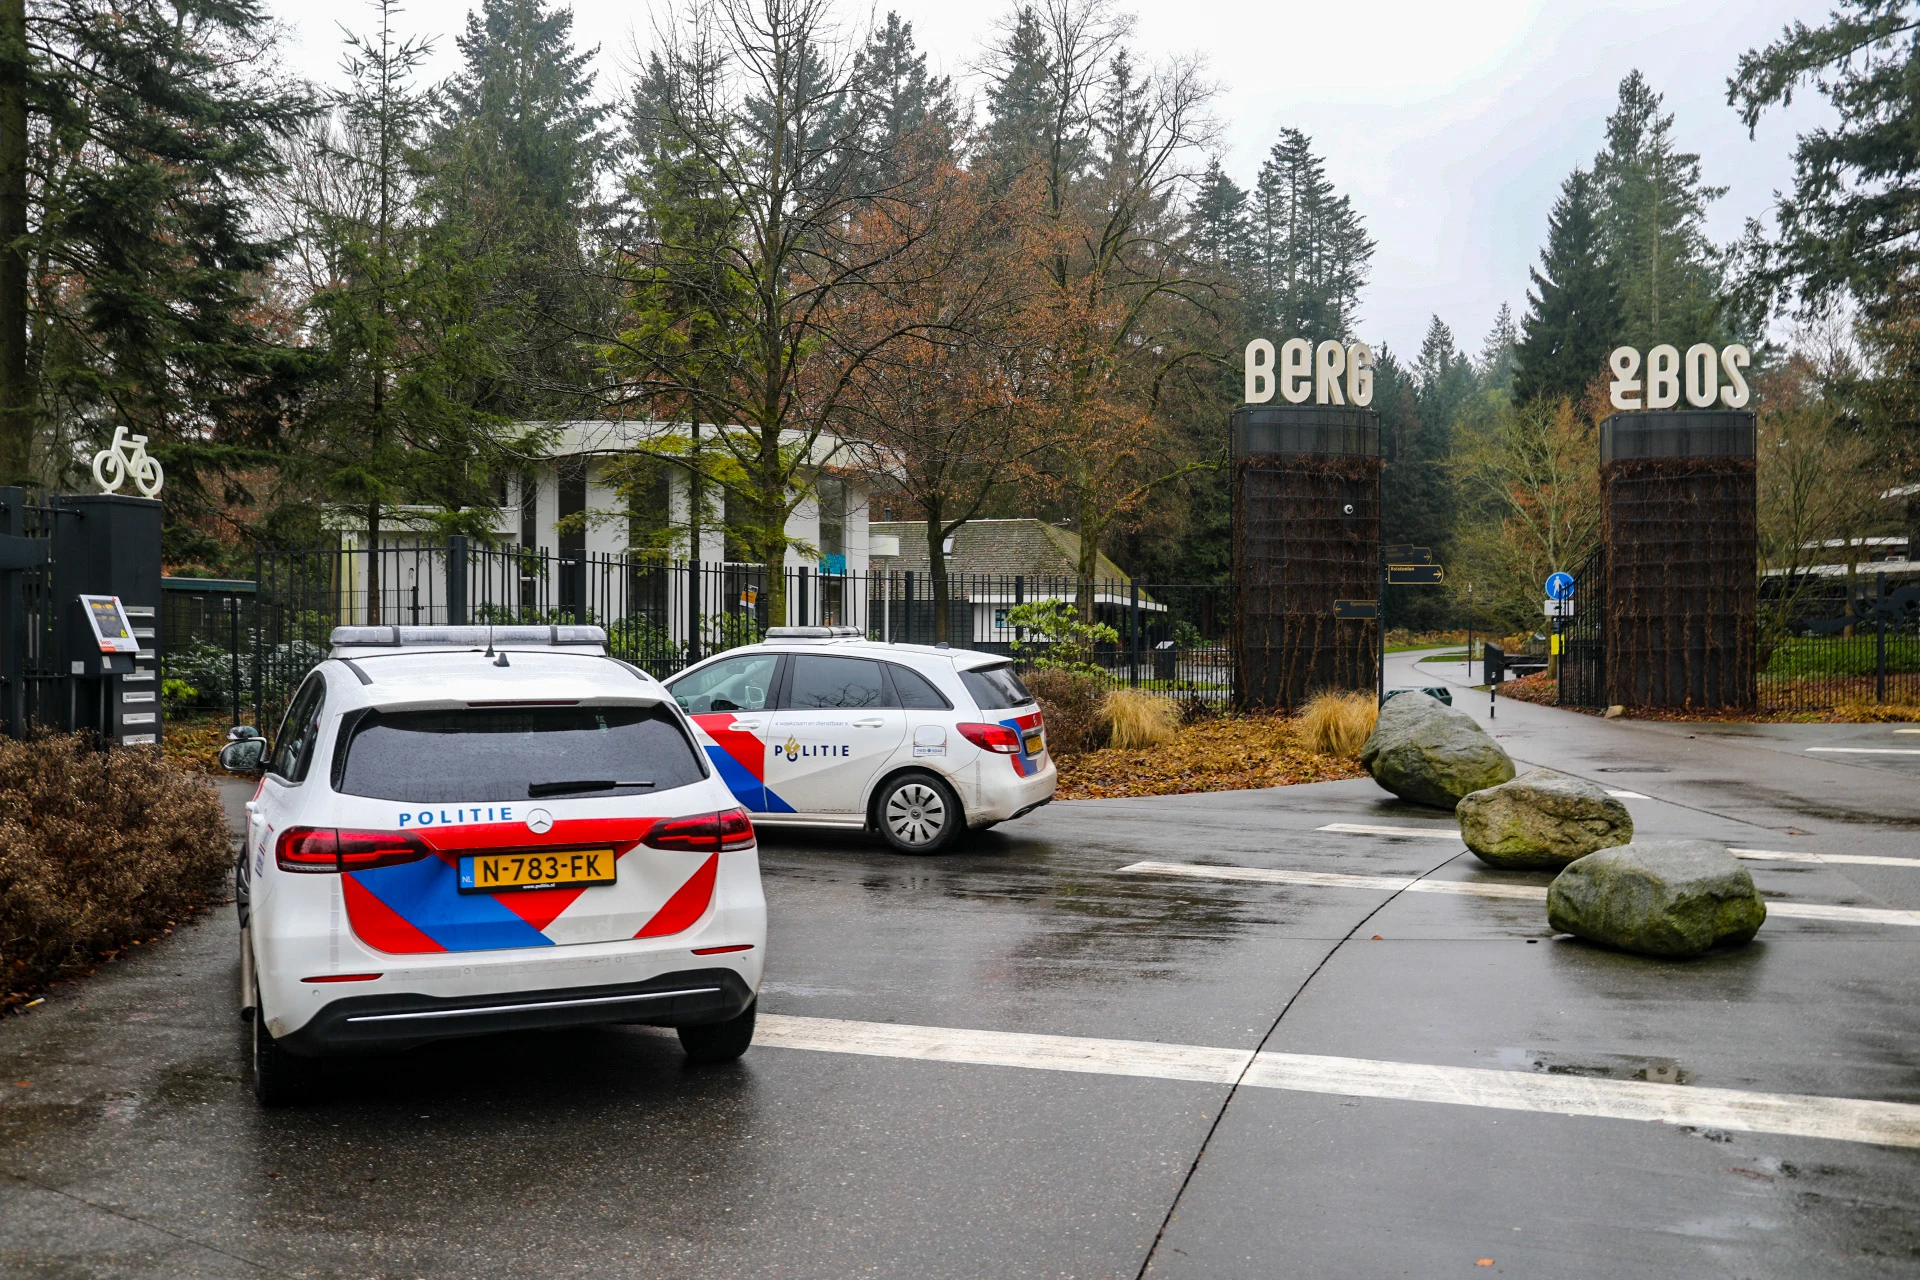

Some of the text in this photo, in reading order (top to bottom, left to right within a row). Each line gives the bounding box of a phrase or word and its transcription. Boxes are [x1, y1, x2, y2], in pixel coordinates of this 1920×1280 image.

[775, 745, 849, 762] POLITIE
[399, 807, 513, 827] POLITIE
[483, 855, 601, 882] N-783-FK
[461, 875, 473, 883] NL
